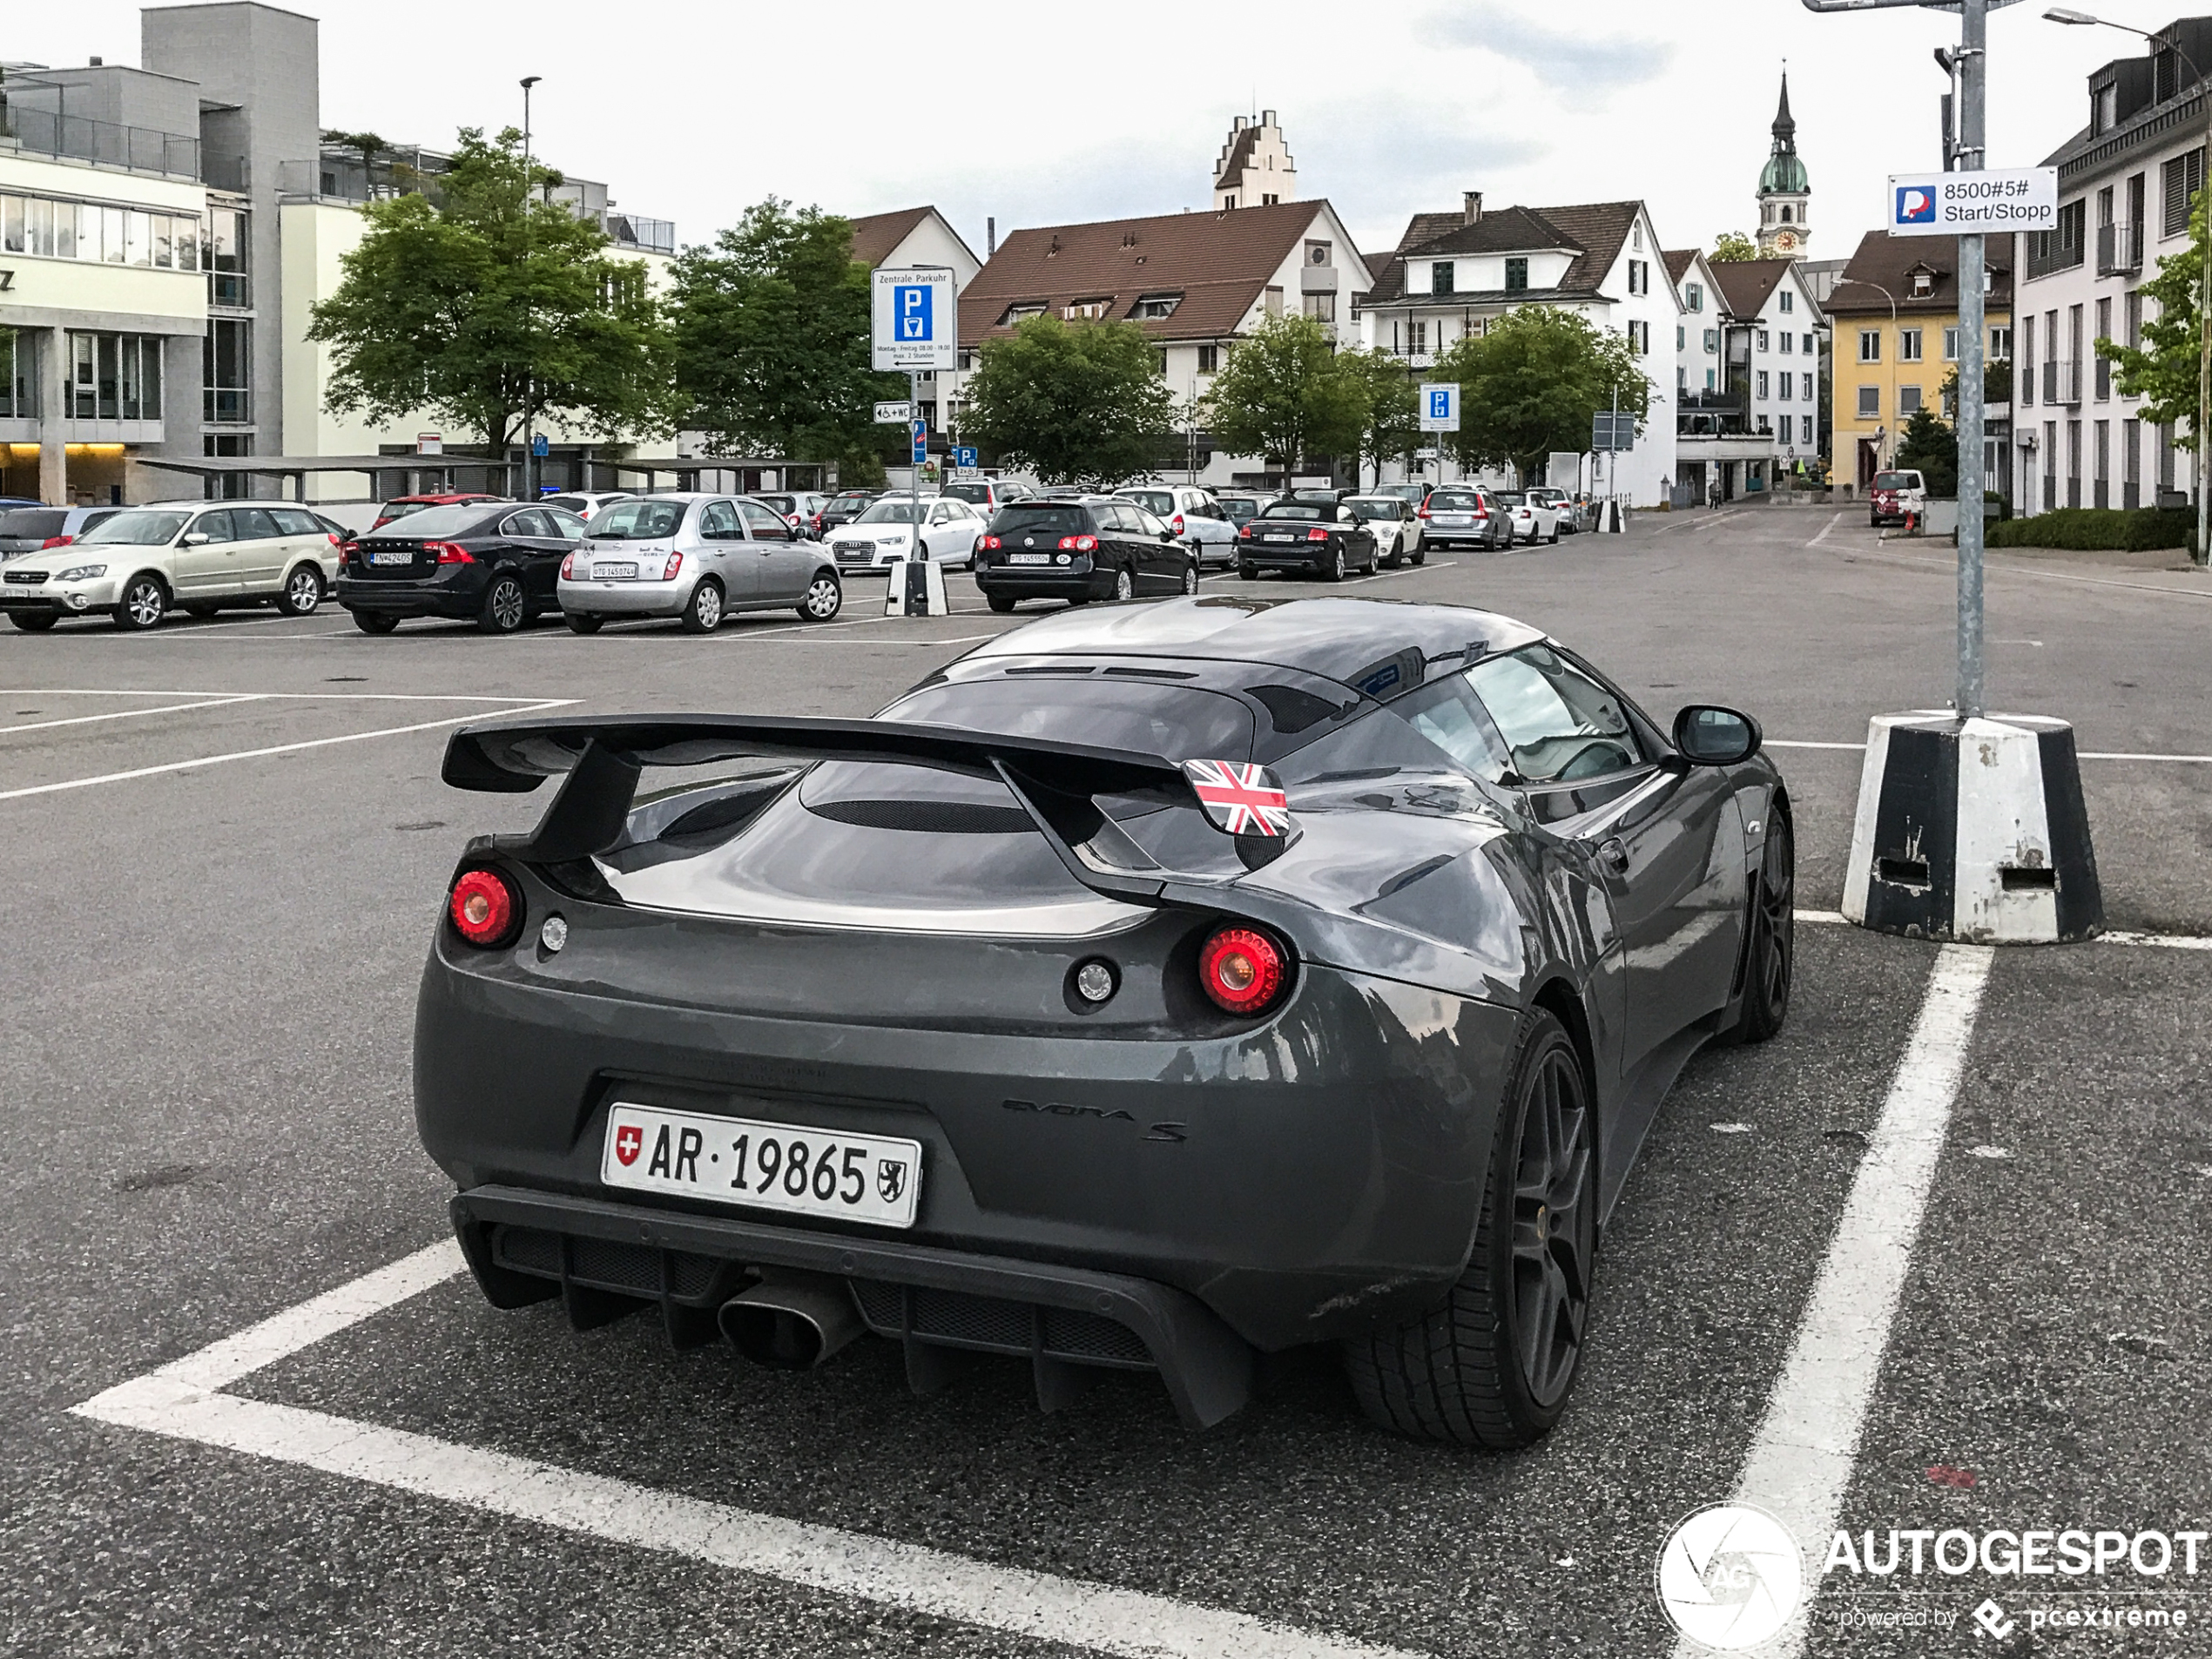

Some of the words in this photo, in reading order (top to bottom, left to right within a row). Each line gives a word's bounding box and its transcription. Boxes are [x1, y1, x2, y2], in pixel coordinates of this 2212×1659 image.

[1945, 180, 2029, 199] 8500#5#
[1945, 204, 2051, 221] Start/Stopp
[880, 274, 913, 283] Zentrale
[916, 273, 947, 282] Parkuhr
[905, 289, 921, 316] P
[1435, 393, 1444, 406] P
[899, 408, 908, 417] WC
[962, 450, 970, 463] P
[1141, 1121, 1188, 1142] S
